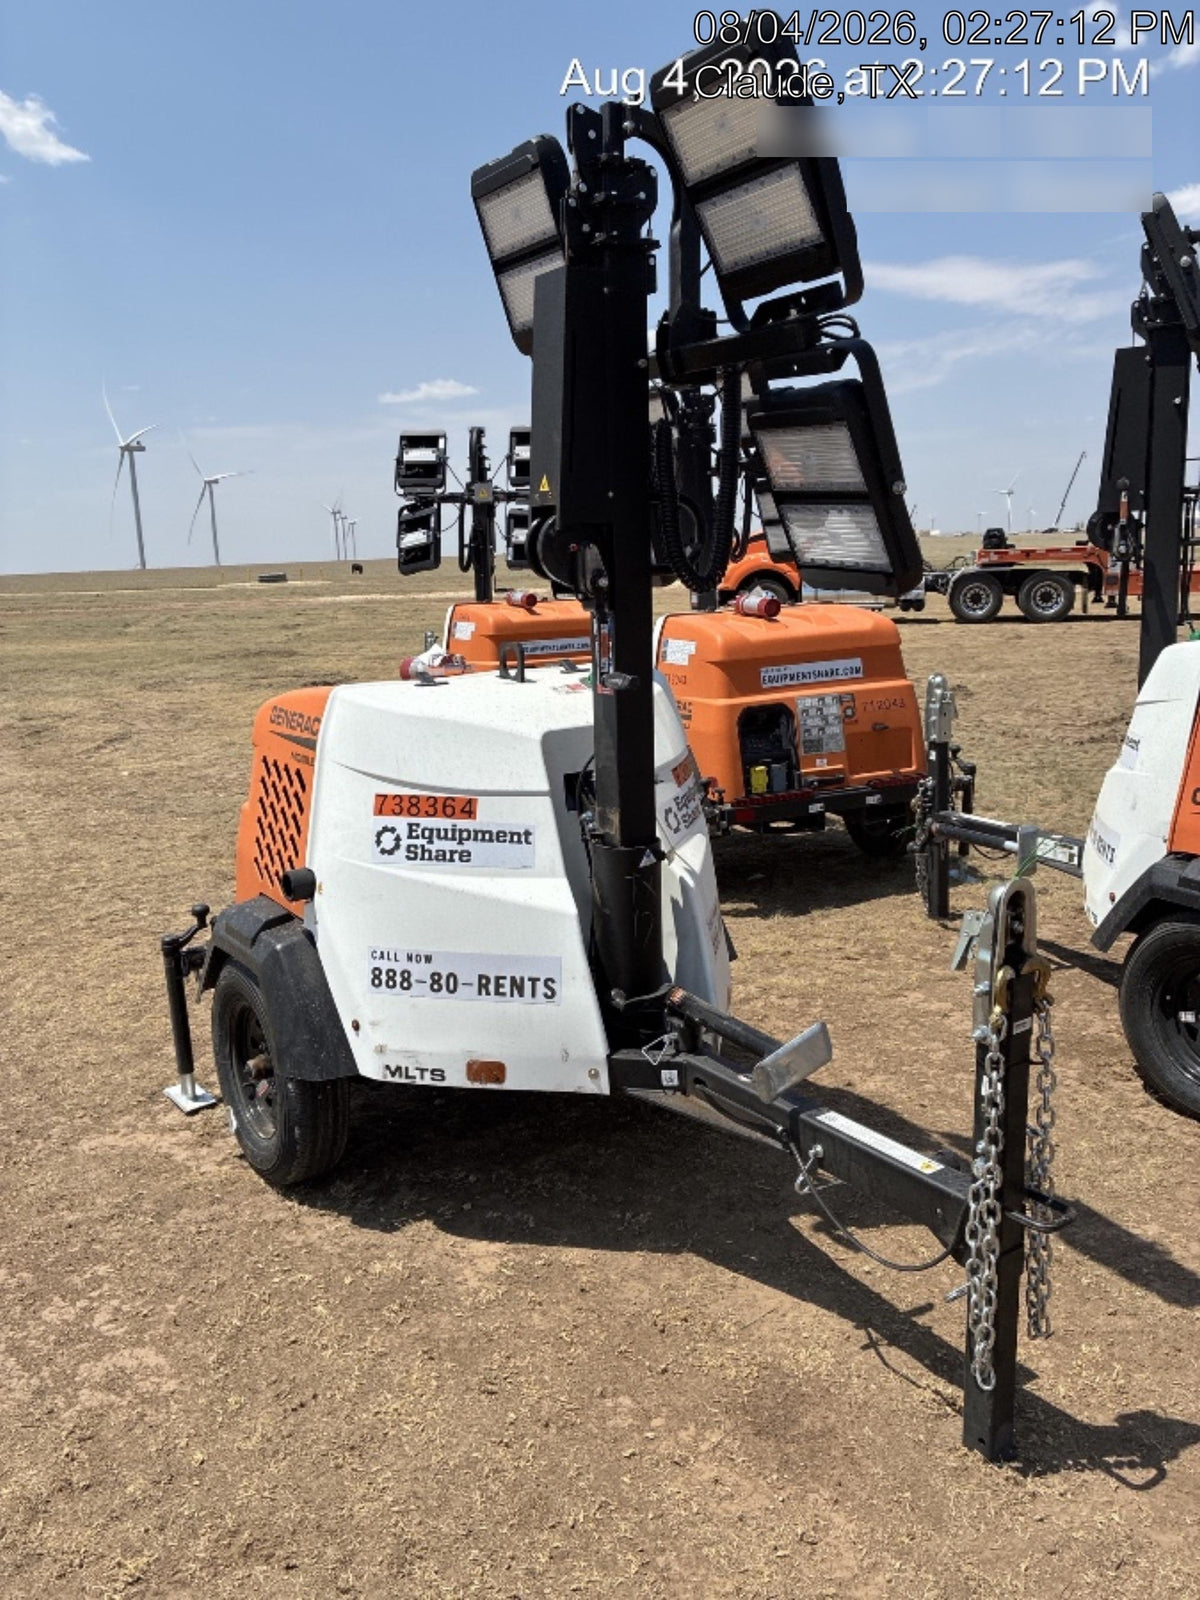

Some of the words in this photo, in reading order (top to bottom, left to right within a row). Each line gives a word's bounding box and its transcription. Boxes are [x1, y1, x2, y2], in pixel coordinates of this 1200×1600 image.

[375, 794, 474, 819] 738364
[406, 823, 532, 845] Equipment
[405, 844, 472, 863] Share
[370, 950, 400, 963] CALL
[407, 953, 433, 965] NOW
[370, 966, 557, 1000] 888-80-RENTS
[385, 1064, 446, 1082] MLTS
